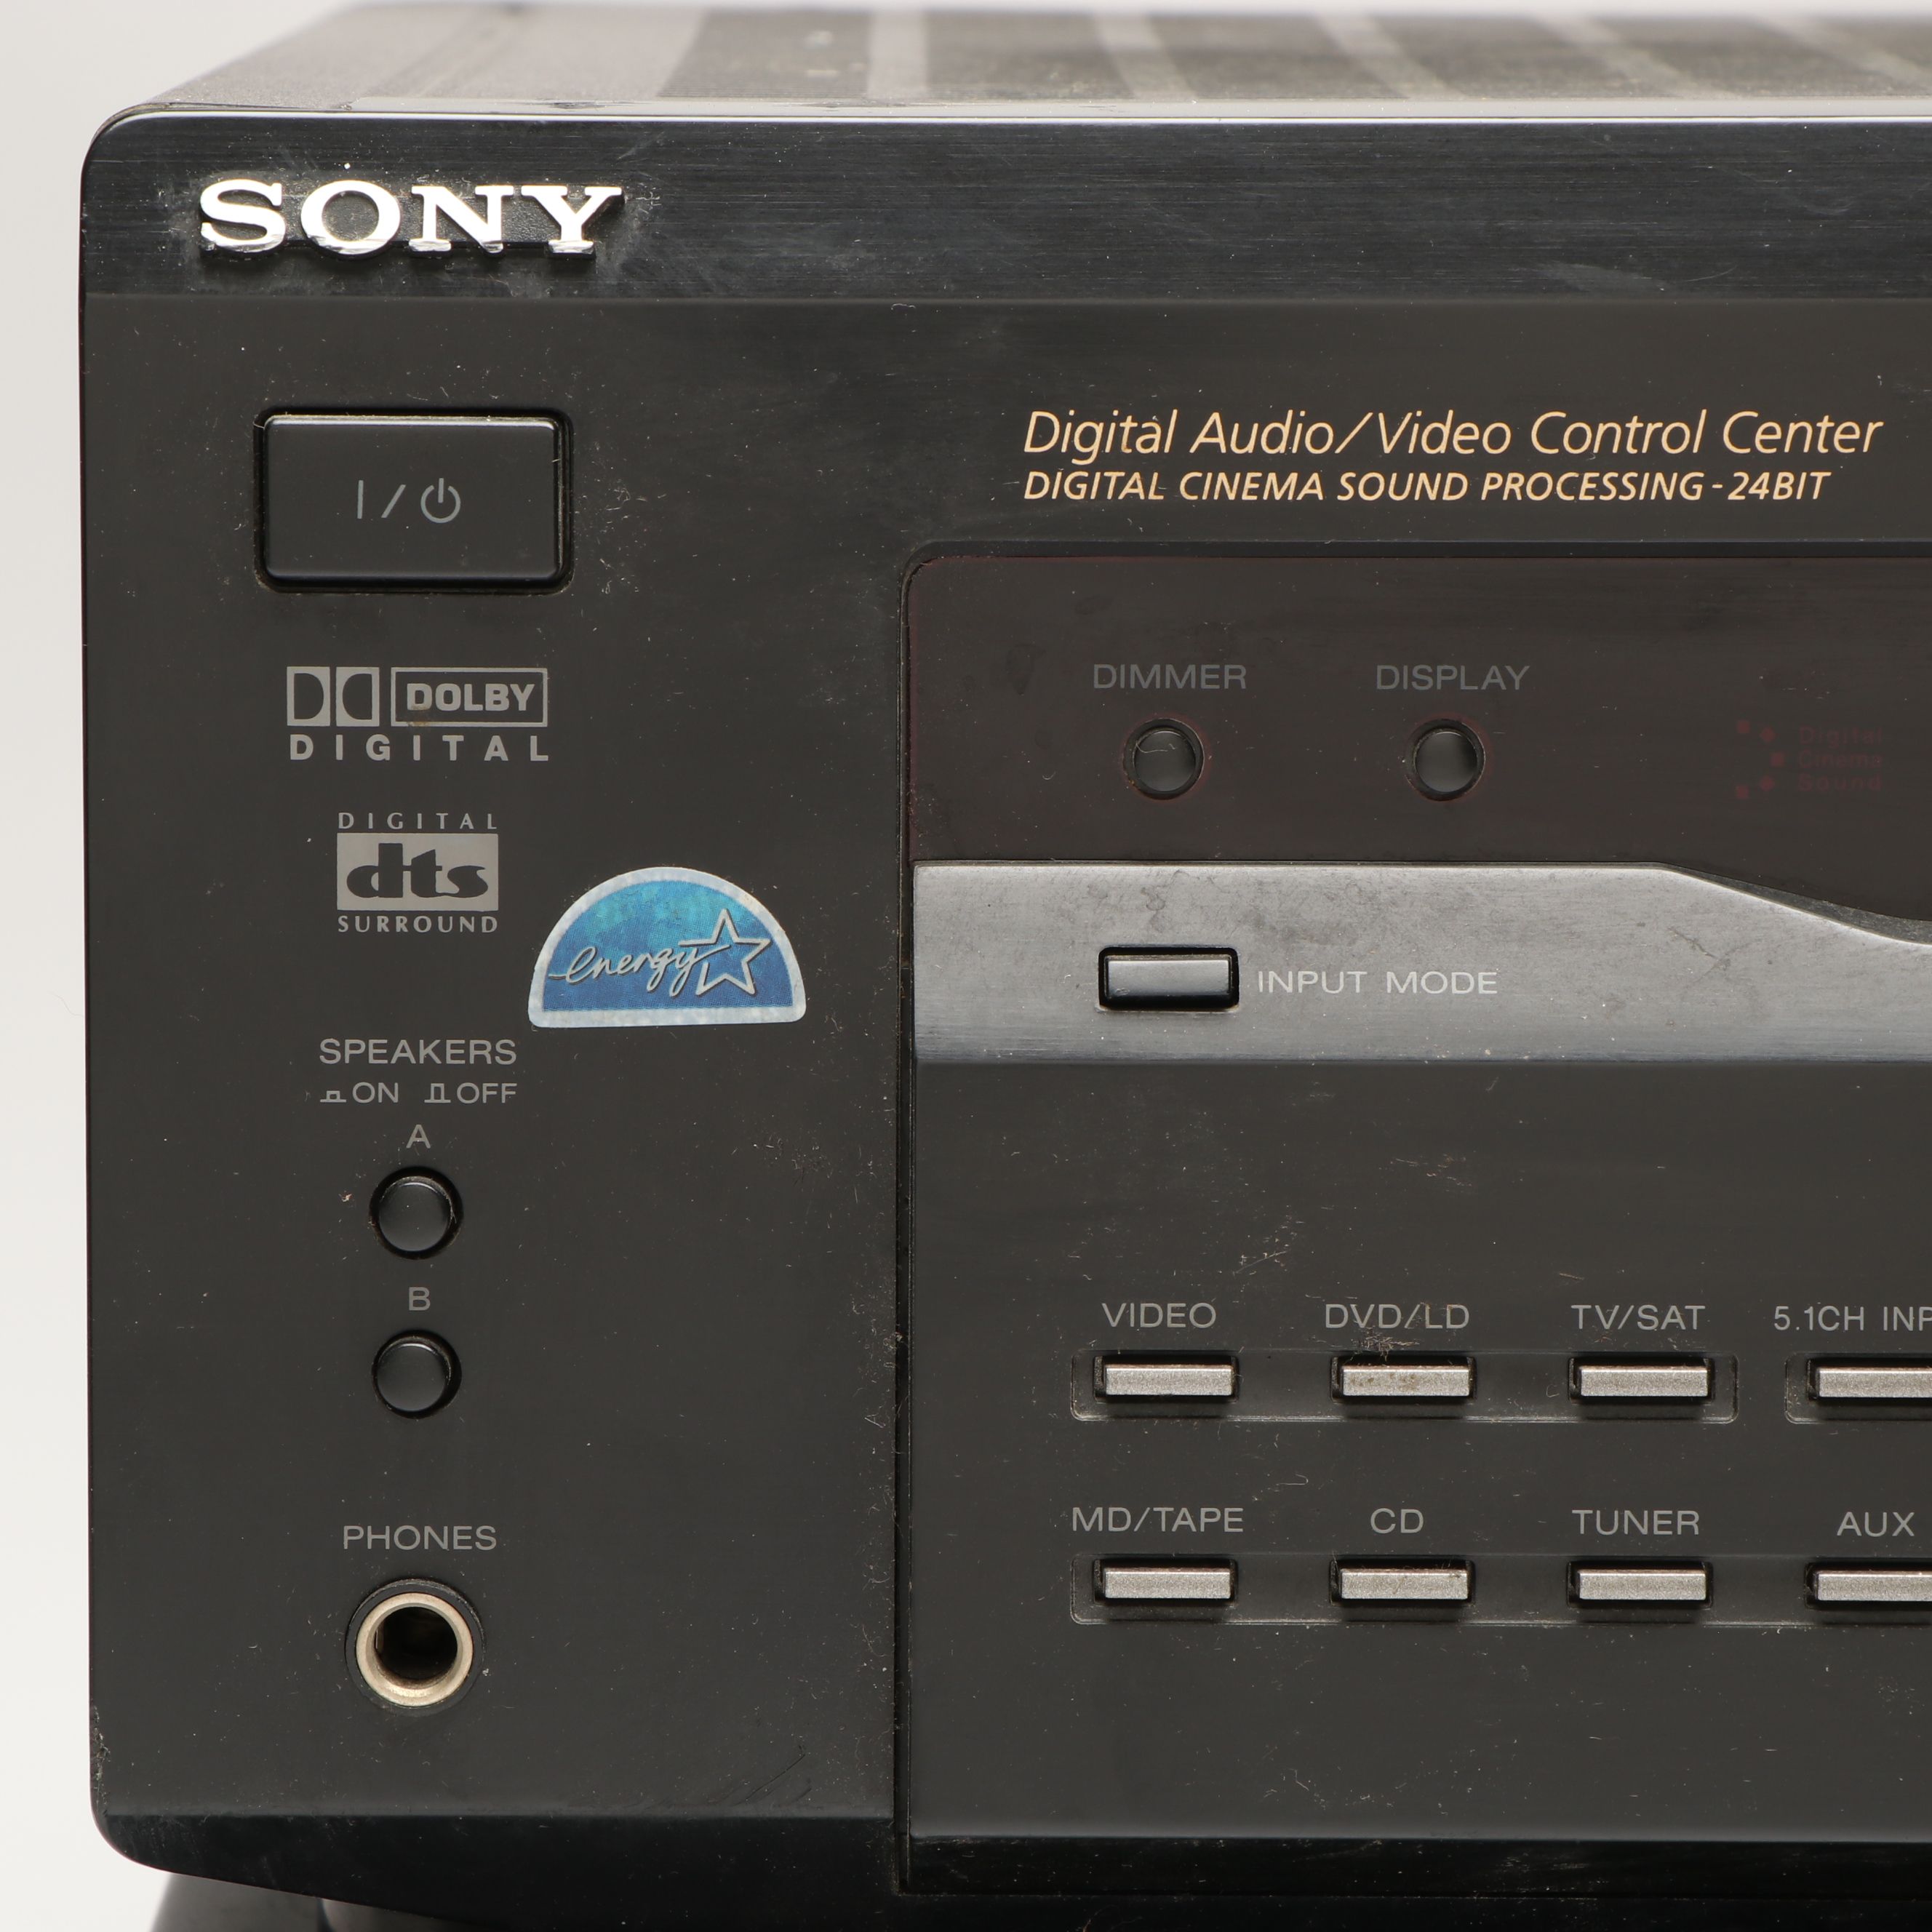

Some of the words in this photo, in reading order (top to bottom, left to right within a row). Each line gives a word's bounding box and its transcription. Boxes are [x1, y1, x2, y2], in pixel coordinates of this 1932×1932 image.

[199, 179, 623, 256] SONY
[1024, 410, 1177, 465] Digital
[1190, 410, 1510, 455] Audio/Video
[1532, 409, 1706, 455] Control
[1723, 411, 1883, 454] Center
[1024, 471, 1164, 500] DIGITAL
[1179, 472, 1323, 500] CINEMA
[1337, 472, 1468, 501] SOUND
[1093, 664, 1248, 690] DIMMER
[1376, 664, 1530, 690] DISPLAY
[406, 683, 535, 712] DOLBY
[290, 734, 549, 762] DIGITAL
[1799, 725, 1884, 748] Digital
[1798, 750, 1883, 769] Cinema
[1797, 773, 1883, 791] Sound
[338, 812, 498, 830] DIGITAL
[346, 842, 490, 900] dts
[338, 915, 498, 933] SURROUND
[548, 943, 730, 998] energy
[1258, 970, 1368, 994] INPUT
[1386, 971, 1498, 994] MODE
[319, 1038, 517, 1065] SPEAKERS
[352, 1082, 399, 1103] ON
[457, 1082, 518, 1104] OFF
[406, 1124, 431, 1149] A
[408, 1287, 431, 1311] B
[1101, 1302, 1217, 1328] VIDEO
[1325, 1304, 1470, 1330] DVD/LD
[1570, 1304, 1707, 1330] TV/SAT
[1773, 1305, 1864, 1331] 5.1CH
[1072, 1506, 1245, 1533] MD/TAPE
[1370, 1508, 1424, 1534] CD
[1571, 1509, 1700, 1536] TUNER
[1837, 1512, 1915, 1537] AUX
[343, 1525, 498, 1551] PHONES
